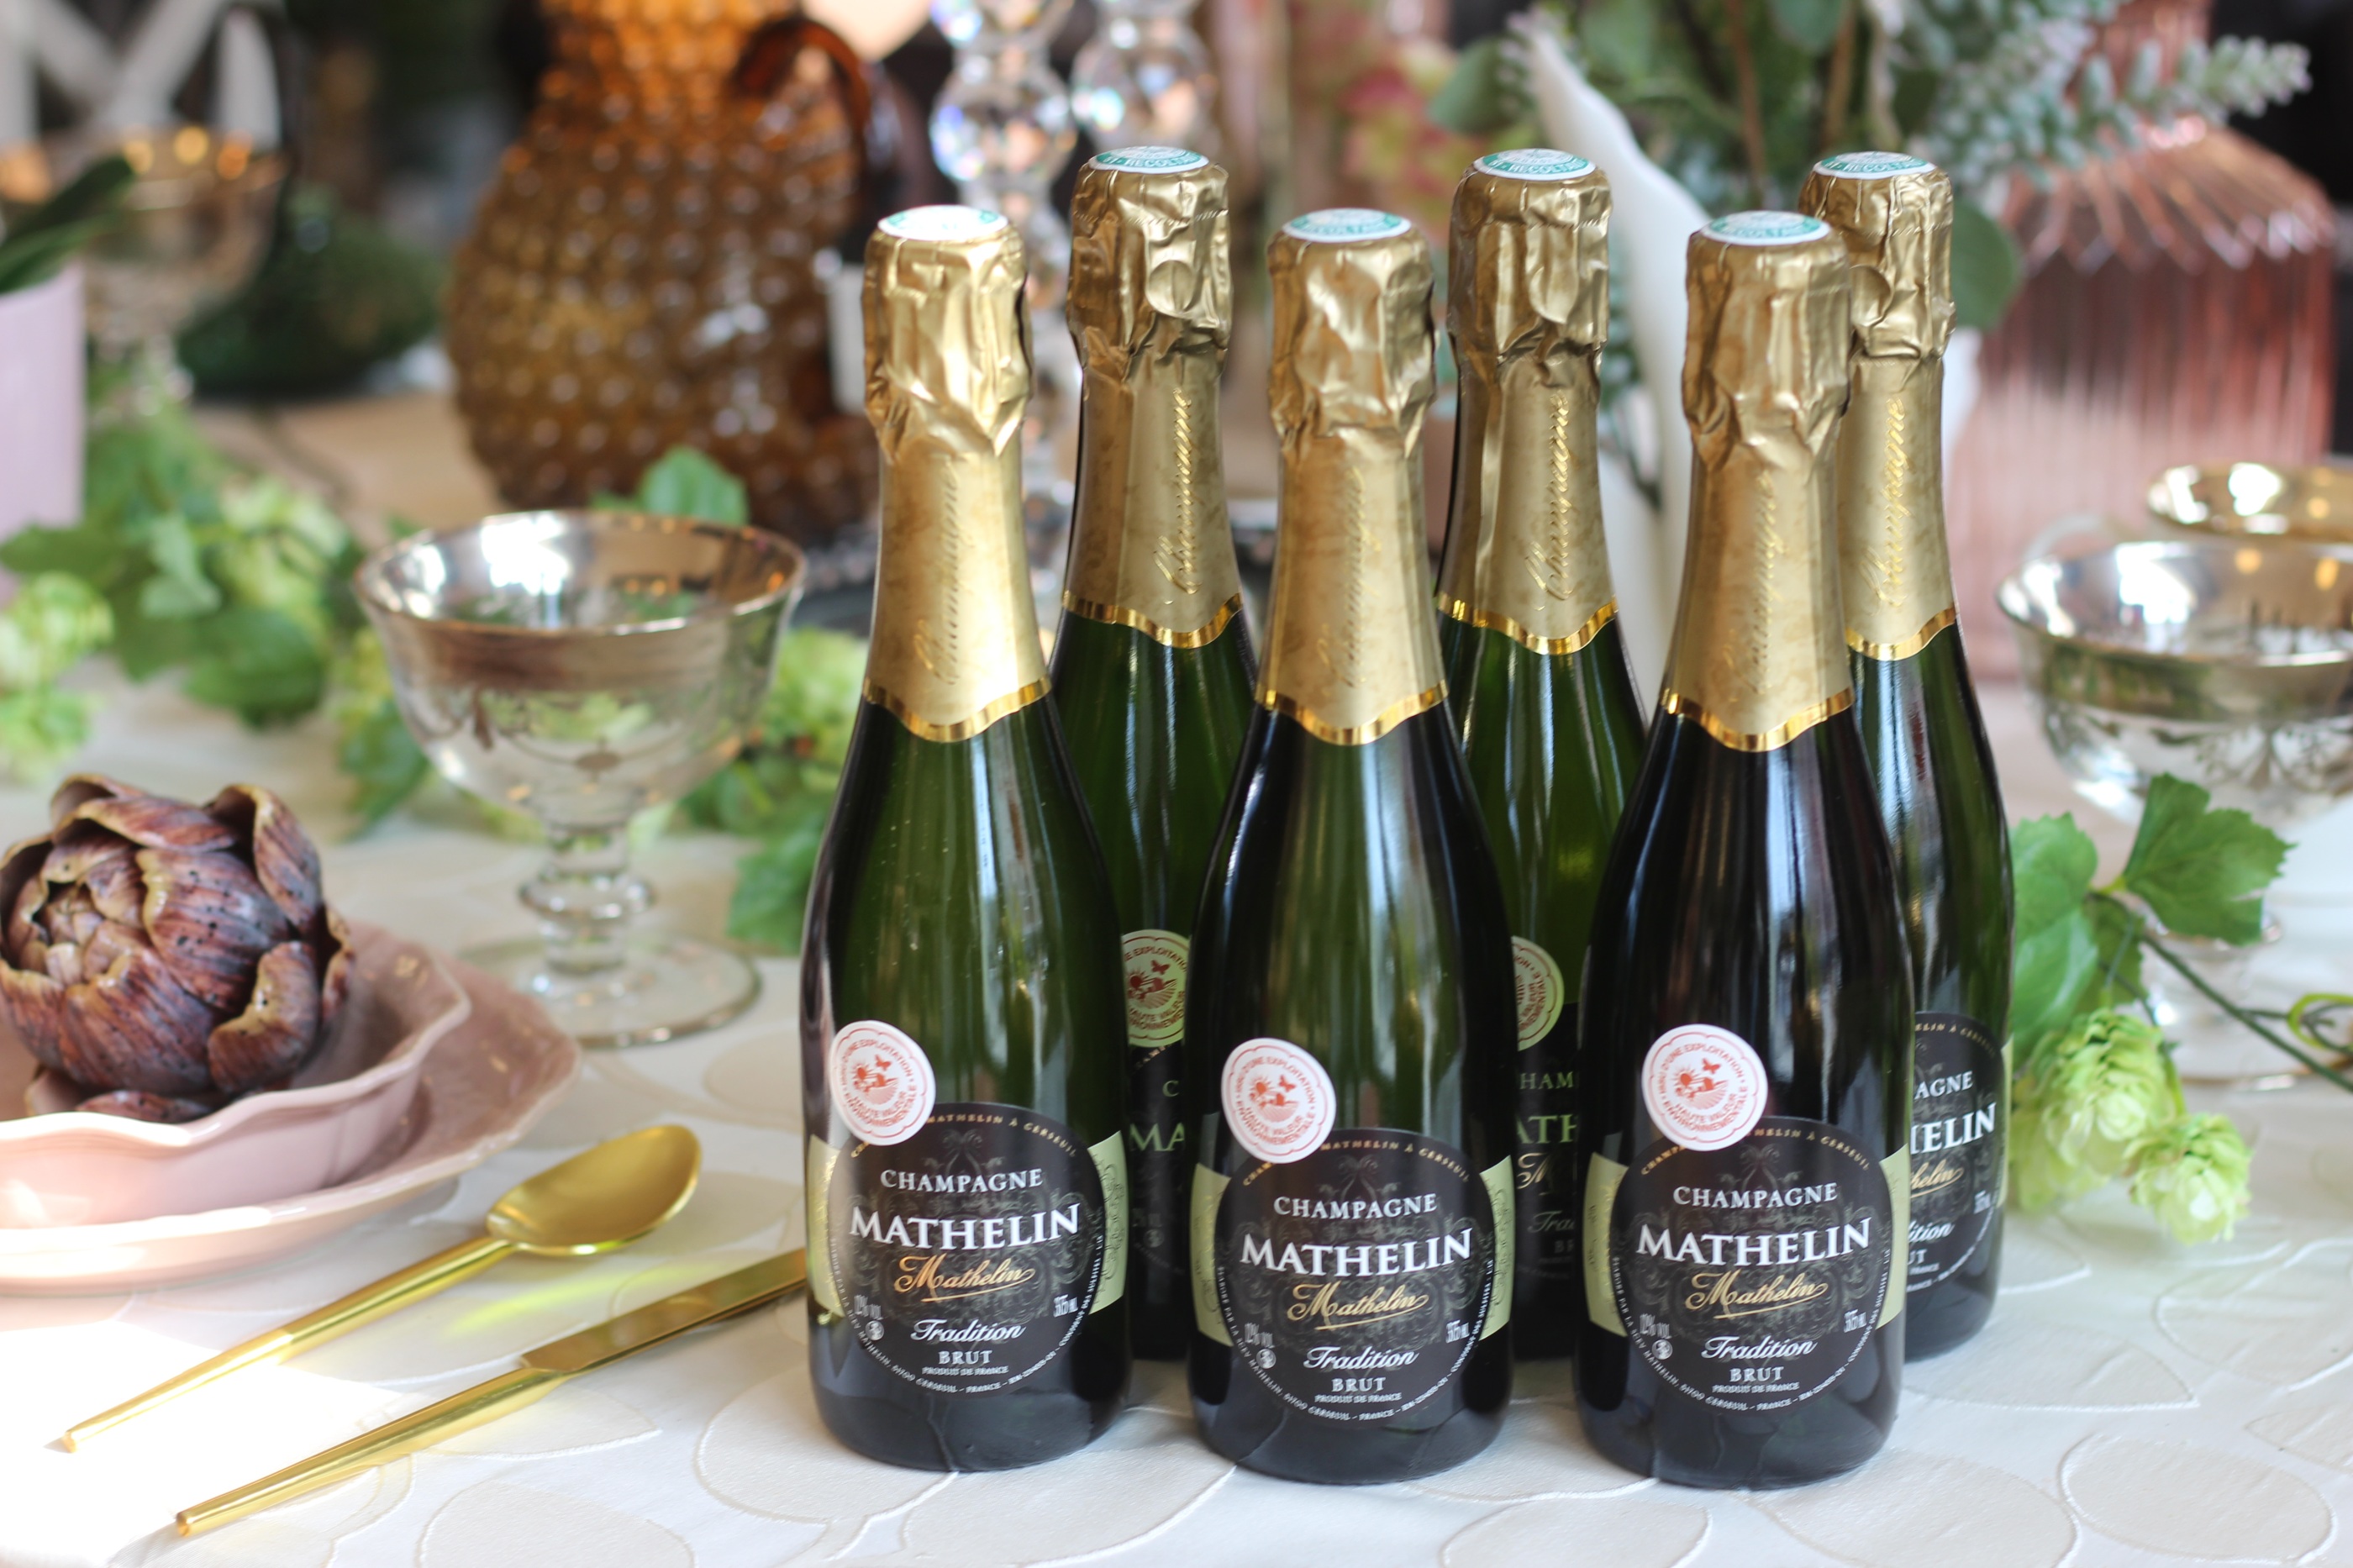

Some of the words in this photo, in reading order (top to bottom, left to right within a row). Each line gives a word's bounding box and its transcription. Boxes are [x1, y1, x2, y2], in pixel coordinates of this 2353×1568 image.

[1154, 387, 1204, 605] Champagne
[1524, 390, 1581, 611] Champagne
[1859, 397, 1917, 617] Champagne
[1910, 1102, 1997, 1155] ELIN
[1641, 1146, 1687, 1175] CHAMP
[1747, 1129, 1801, 1138] HELIN
[880, 1168, 1044, 1193] CHAMPAGNE
[1910, 1159, 1964, 1198] helin
[1274, 1193, 1438, 1219] CHAMPAGNE
[1672, 1182, 1839, 1209] CHAMPAGNE
[850, 1202, 1081, 1250] MATHELIN
[1908, 1220, 1956, 1242] ition
[1240, 1227, 1473, 1277] MATHELIN
[1636, 1217, 1872, 1266] MATHELIN
[893, 1253, 1036, 1303] Mathelin
[1287, 1280, 1429, 1331] Mathelin
[1685, 1268, 1829, 1320] Mathelin
[910, 1318, 1026, 1343] Tradition
[938, 1350, 992, 1365] BRUT
[1303, 1346, 1419, 1369] Tradition
[1701, 1335, 1818, 1359] Tradition
[922, 1366, 959, 1376] PRODUIT
[960, 1367, 974, 1376] DE
[975, 1365, 1009, 1375] FRANCE
[1729, 1366, 1784, 1382] BRUT
[1314, 1394, 1352, 1403] PRODUIT
[1353, 1395, 1367, 1403] DE
[1368, 1392, 1402, 1402] FRANCE
[1331, 1377, 1386, 1392] BRUT
[1712, 1385, 1750, 1393] PRODUIT
[1751, 1385, 1766, 1393] DE
[1766, 1382, 1799, 1392] FRANCE
